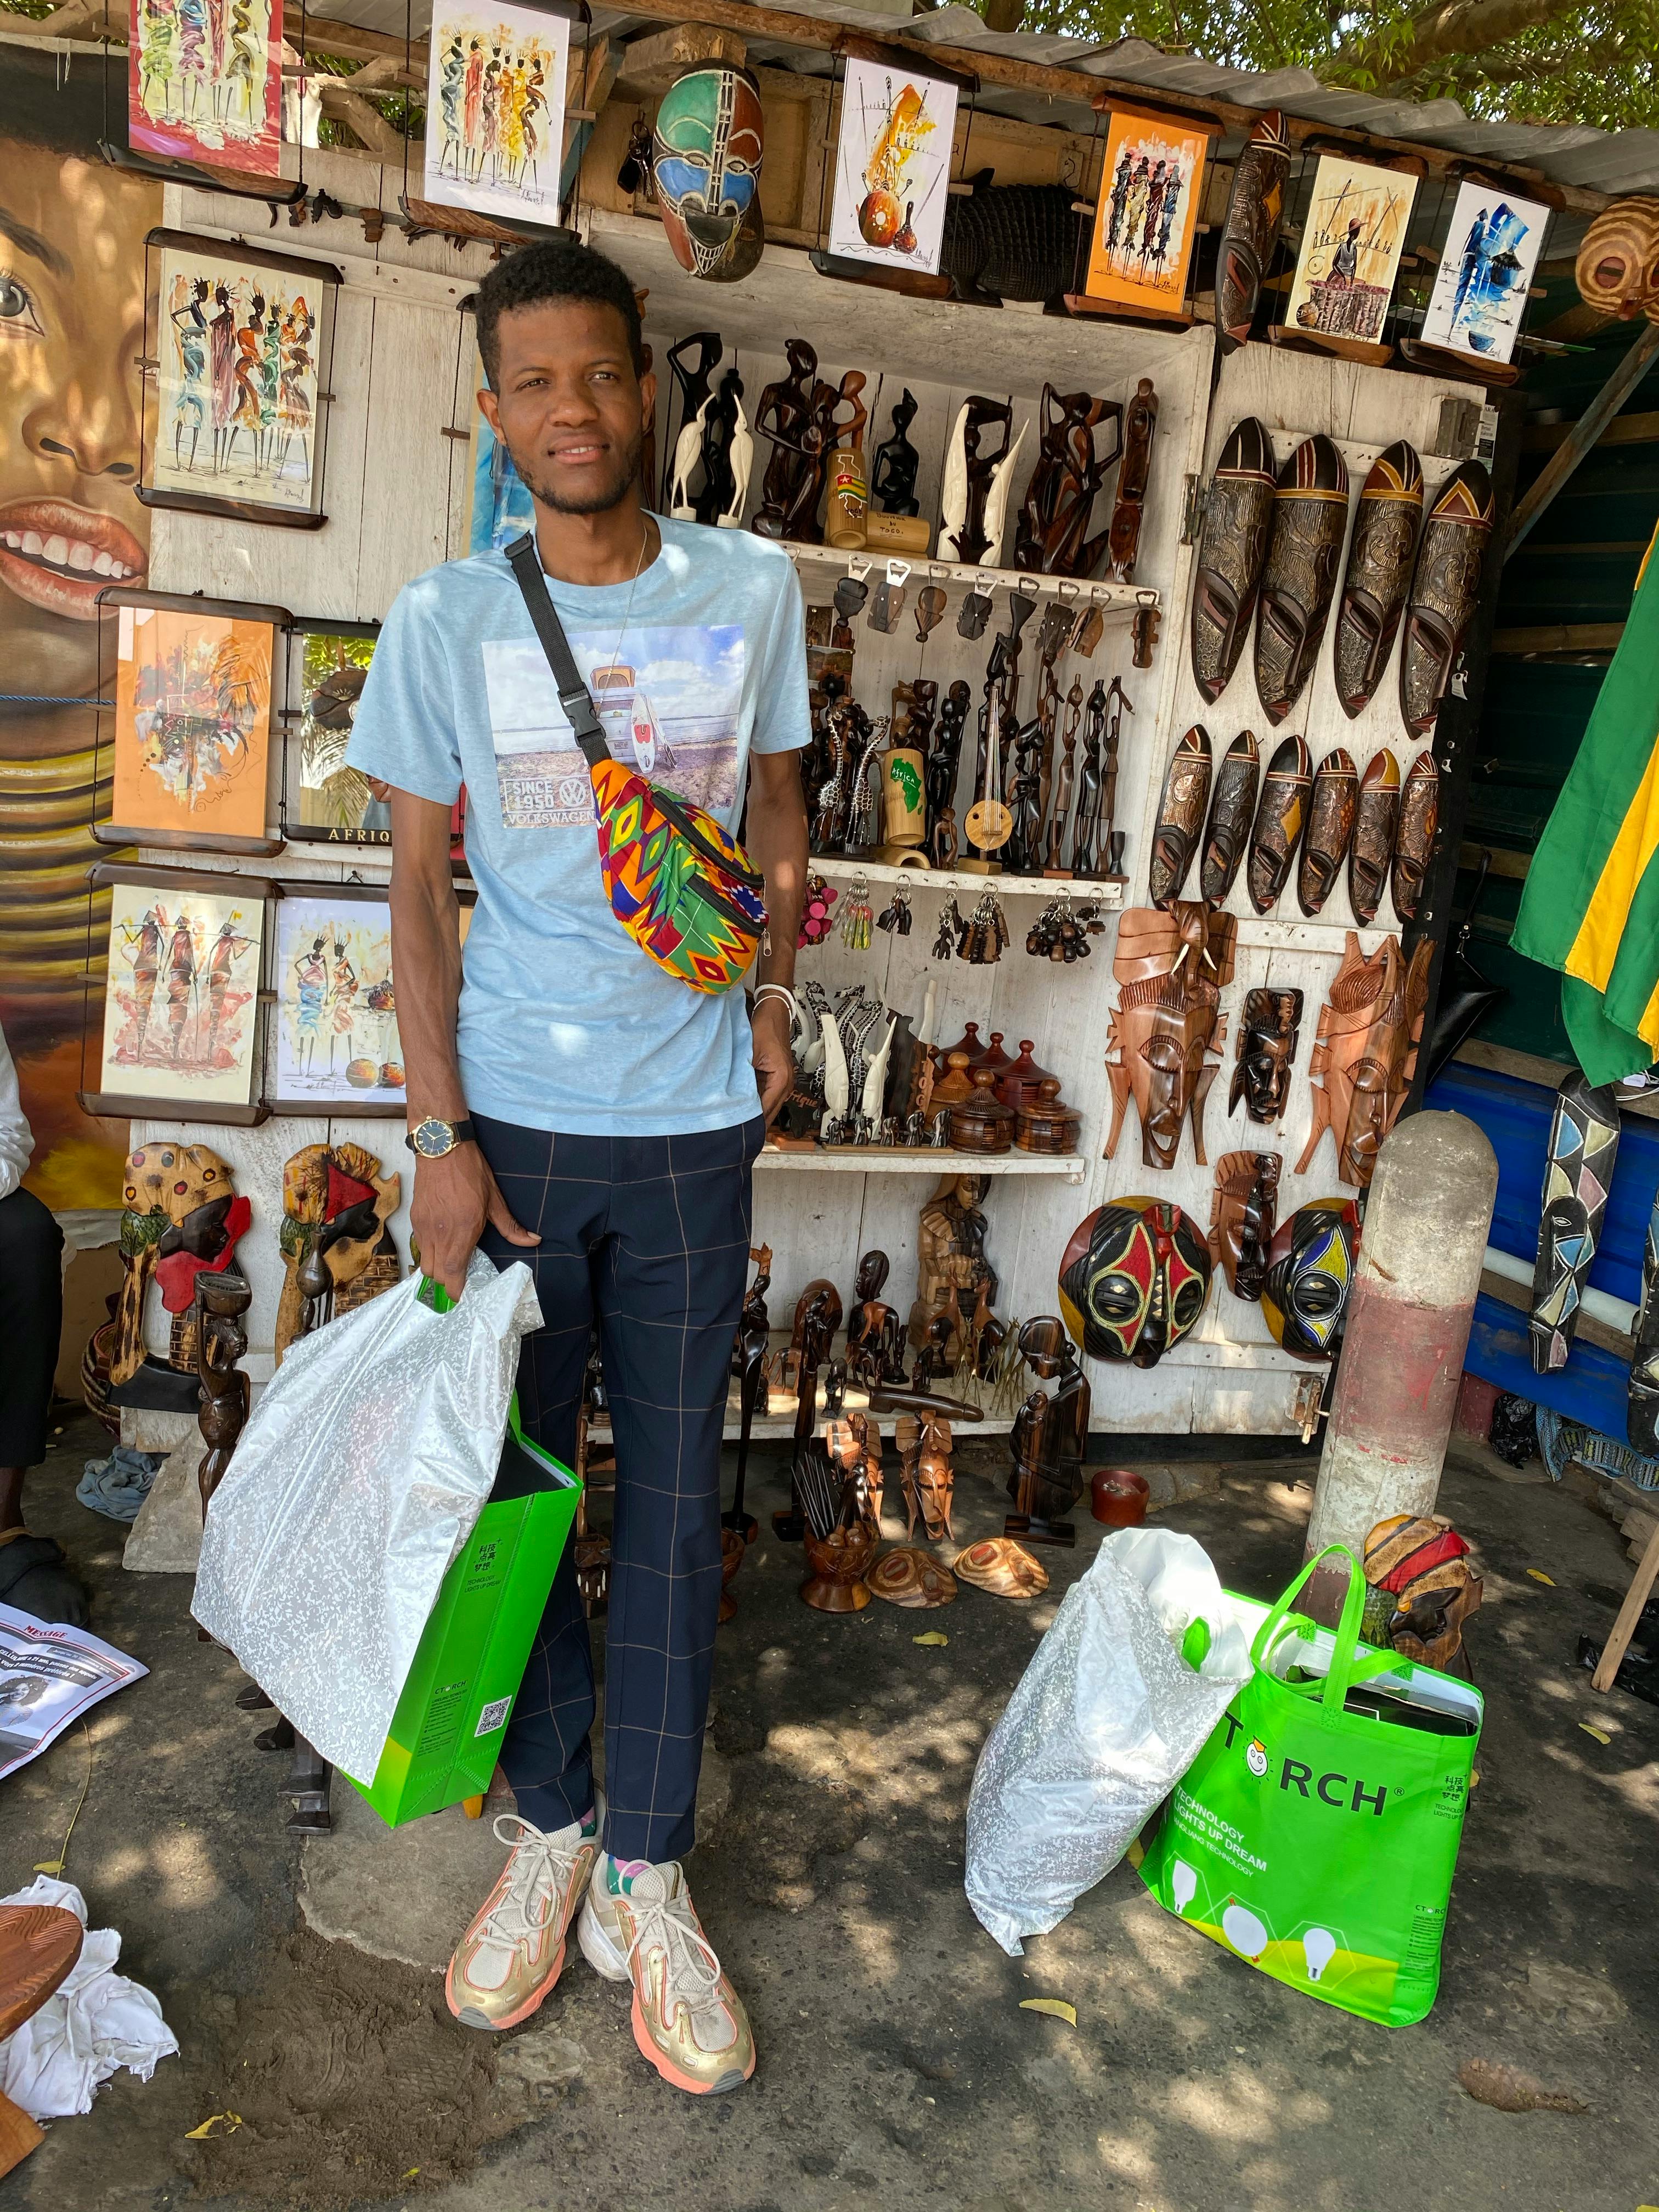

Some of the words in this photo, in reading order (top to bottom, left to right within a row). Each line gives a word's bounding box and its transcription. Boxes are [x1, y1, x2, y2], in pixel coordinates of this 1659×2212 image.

[512, 780, 554, 795] SINCE
[515, 794, 554, 809] 1950
[508, 810, 596, 825] VOLKSWAGEN
[328, 828, 390, 843] AFRIQ
[915, 1060, 928, 1113] TOG
[785, 1089, 817, 1108] frique
[78, 1669, 97, 1680] appels
[1177, 1786, 1245, 1843] TECHNOLOGY
[1174, 1798, 1206, 1832] LIGHTS
[1208, 1826, 1223, 1842] UP
[1224, 1838, 1267, 1872] DREAM
[1206, 1841, 1254, 1878] TECHNOLOGY
